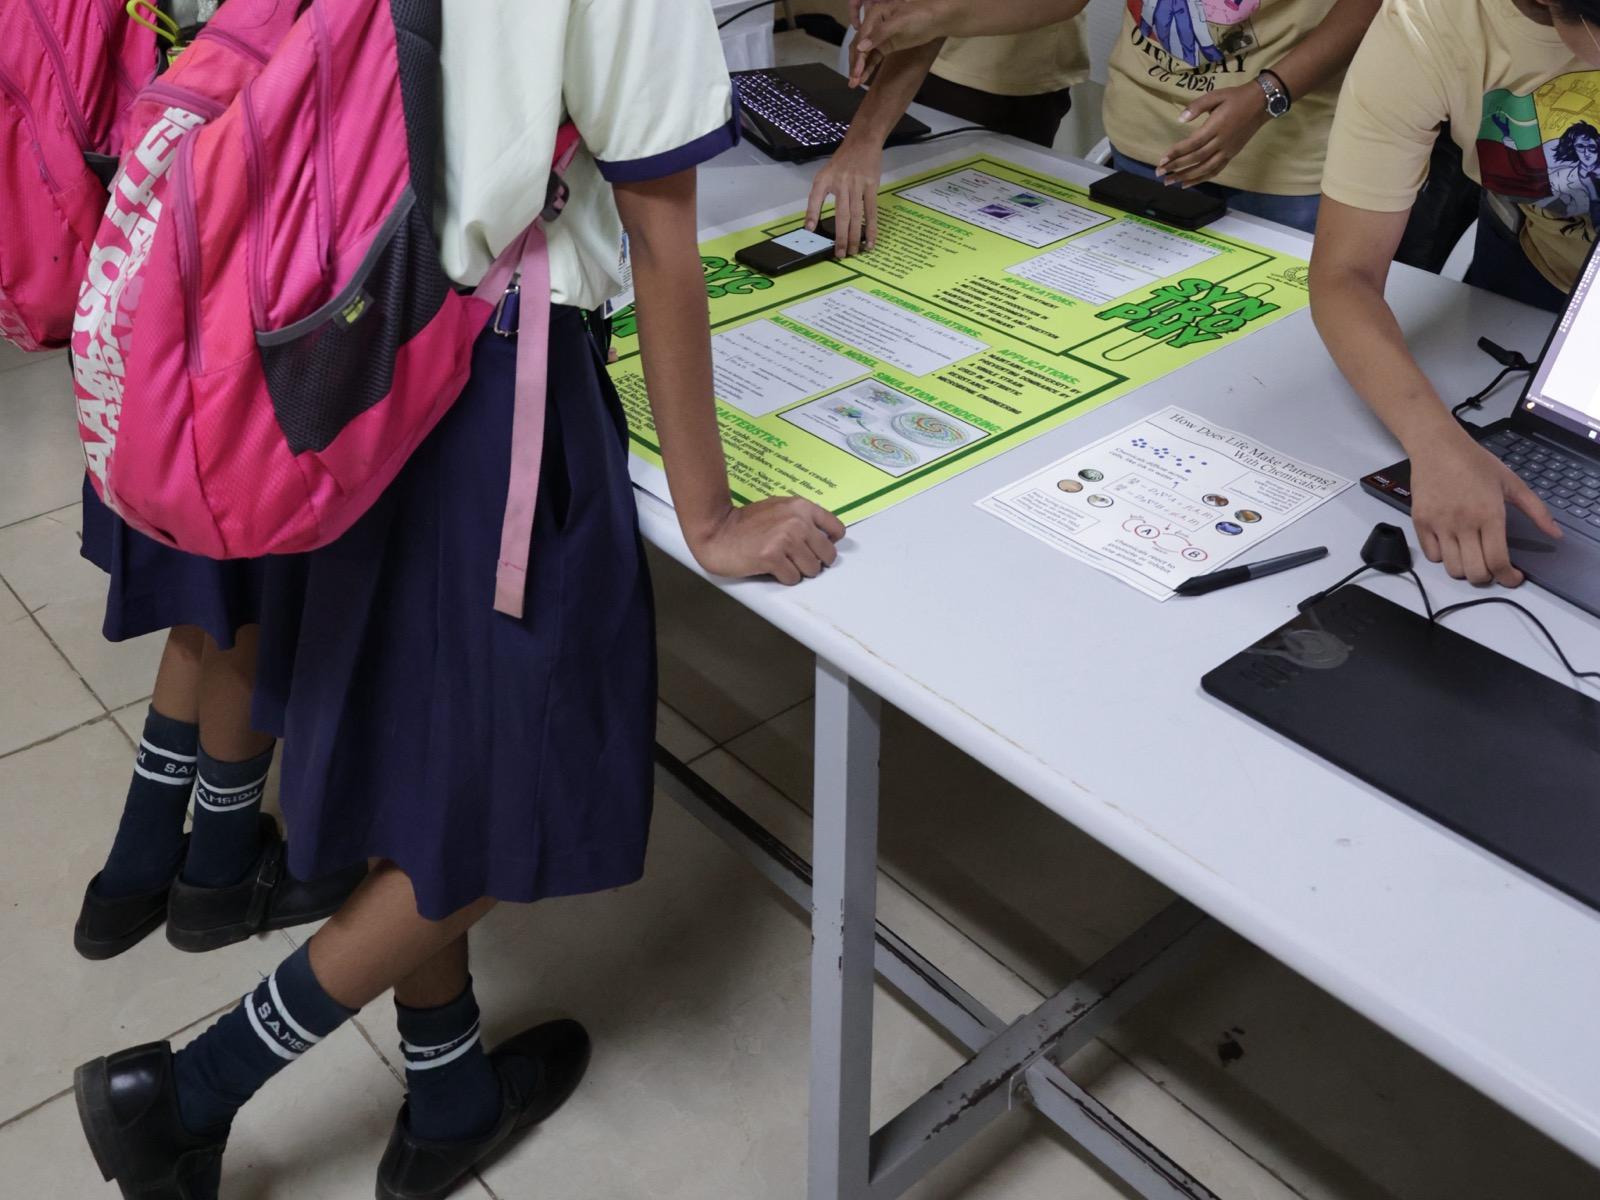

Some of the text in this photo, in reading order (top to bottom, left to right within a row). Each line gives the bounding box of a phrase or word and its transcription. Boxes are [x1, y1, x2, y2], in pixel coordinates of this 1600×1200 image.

[1175, 72, 1216, 92] 2026
[869, 288, 925, 313] GOVERNING
[1022, 293, 1059, 309] TREATMENT
[1166, 277, 1281, 322] SYN
[1094, 302, 1223, 349] PHY
[771, 315, 879, 367] MATHEMATICAL MODEL
[873, 371, 938, 403] SIMULATION
[947, 371, 990, 390] RESISTANCE
[958, 367, 977, 376] USED
[985, 378, 1023, 396] ANTIBIOTIC
[1000, 375, 1025, 388] STRAIN
[1019, 375, 1059, 394] DOMINANCE
[1169, 413, 1337, 486] How Does Life Make Patterns?
[1233, 449, 1259, 468] With
[773, 452, 794, 464] rather
[793, 463, 809, 473] than
[1141, 528, 1153, 536] A
[1187, 550, 1201, 559] B
